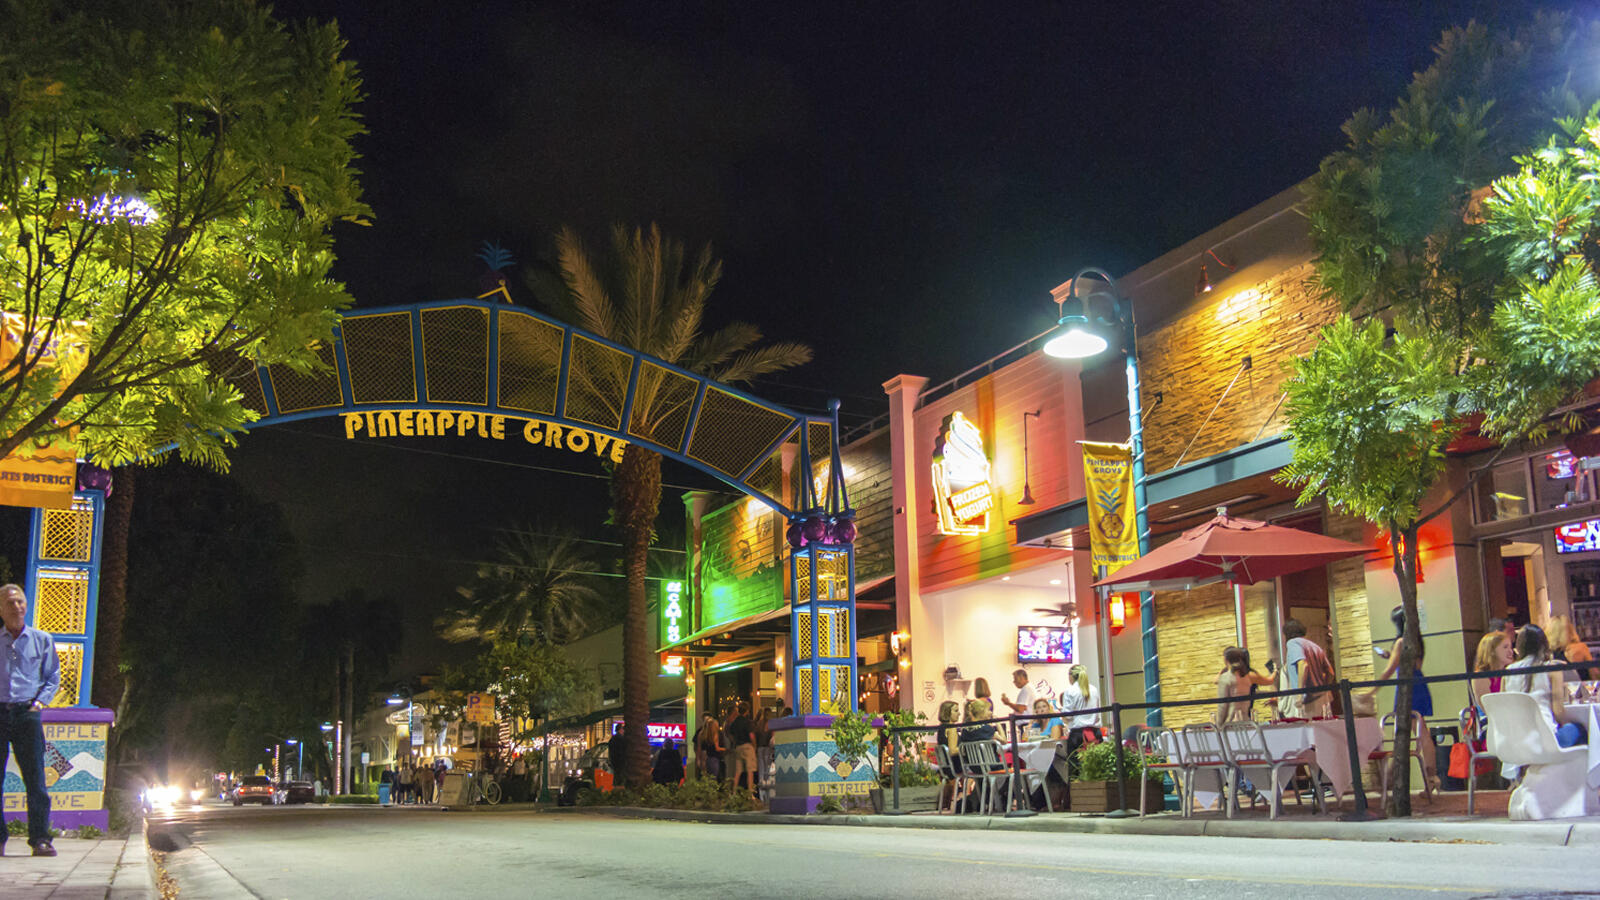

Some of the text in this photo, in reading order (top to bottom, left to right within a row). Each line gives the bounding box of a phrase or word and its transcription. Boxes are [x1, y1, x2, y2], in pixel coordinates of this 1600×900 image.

[345, 410, 627, 463] PINEAPPLE GROVE
[1094, 467, 1122, 475] GROVE
[23, 473, 72, 485] DISTRICT
[951, 482, 991, 507] FROZEN
[955, 495, 993, 521] YOGURT
[46, 725, 99, 738] APPLE
[818, 783, 872, 794] DISTRICT
[4, 795, 85, 808] GVE
